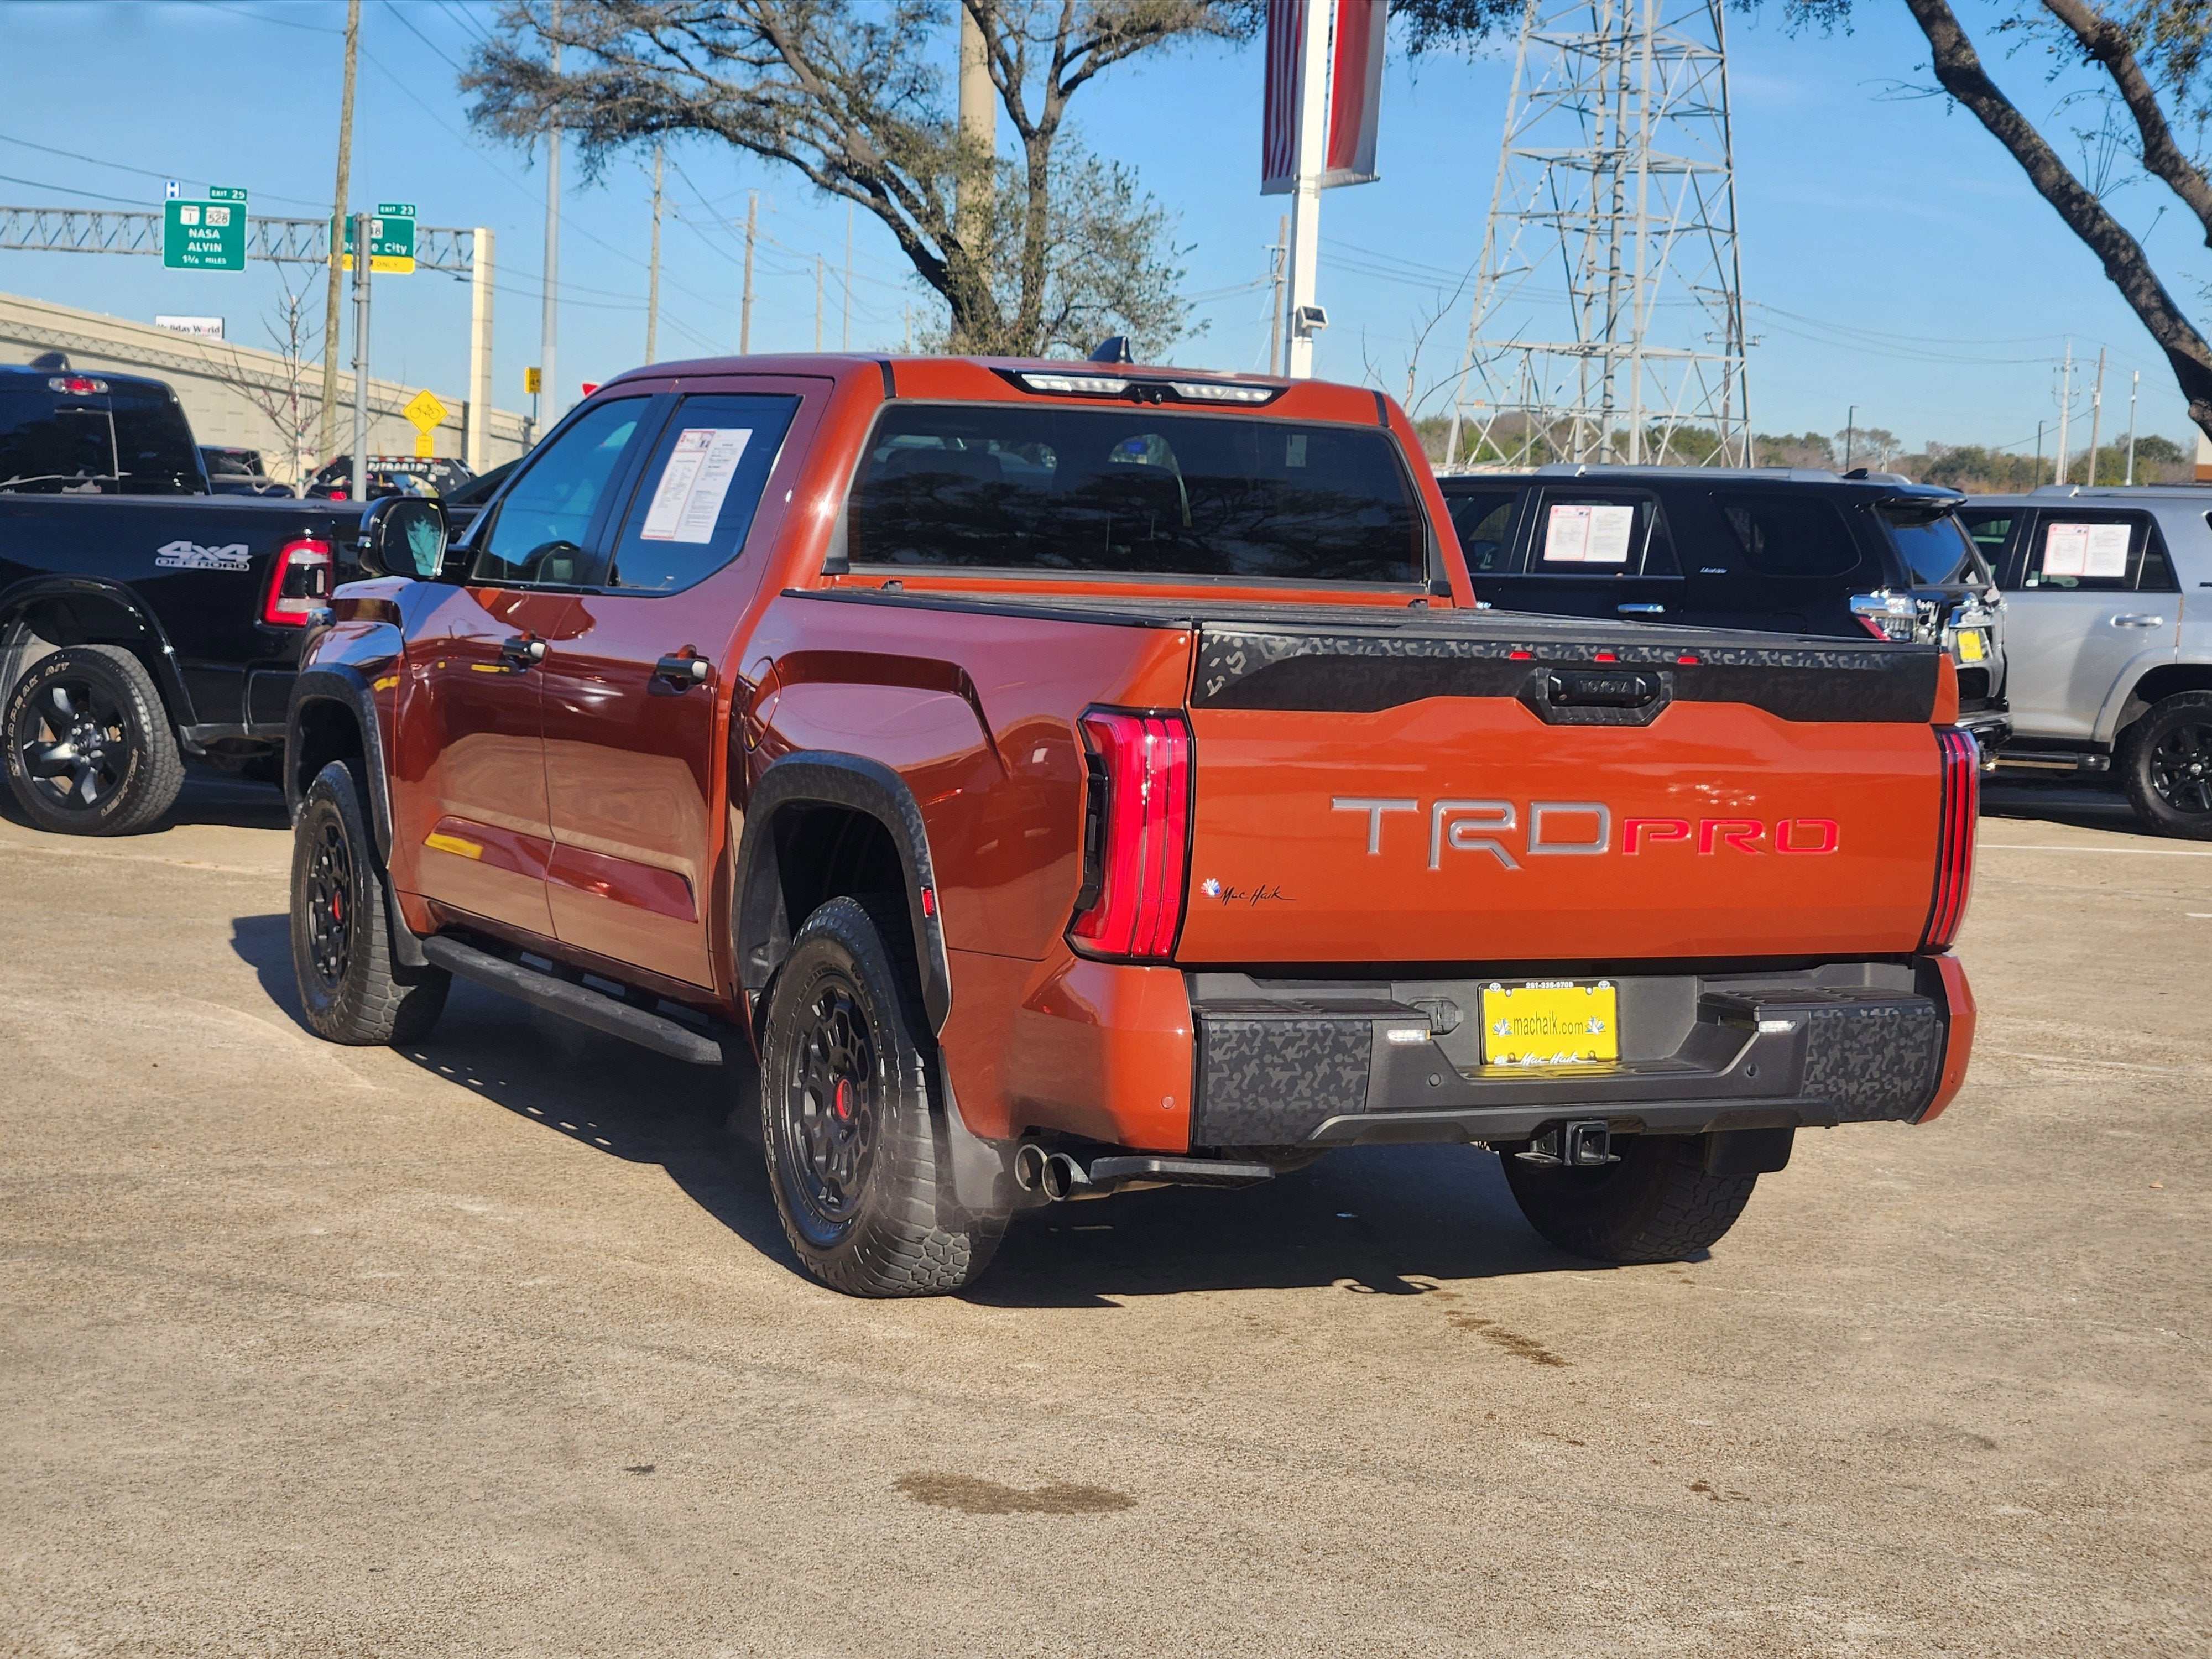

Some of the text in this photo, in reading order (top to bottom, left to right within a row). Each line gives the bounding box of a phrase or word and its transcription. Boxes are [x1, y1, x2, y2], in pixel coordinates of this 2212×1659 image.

[232, 190, 245, 199] 25
[400, 206, 414, 215] 23
[208, 213, 228, 223] 528
[189, 228, 220, 239] NASA
[187, 242, 222, 252] ALVIN
[384, 242, 408, 255] City
[1580, 680, 1631, 693] TOYOTA
[7, 661, 70, 776] WILDPEAK A/T
[100, 747, 138, 816] FALKEN
[1331, 797, 1840, 871] TRD PRO
[1220, 884, 1292, 907] Mac Haik
[1513, 1010, 1583, 1036] machaik.com
